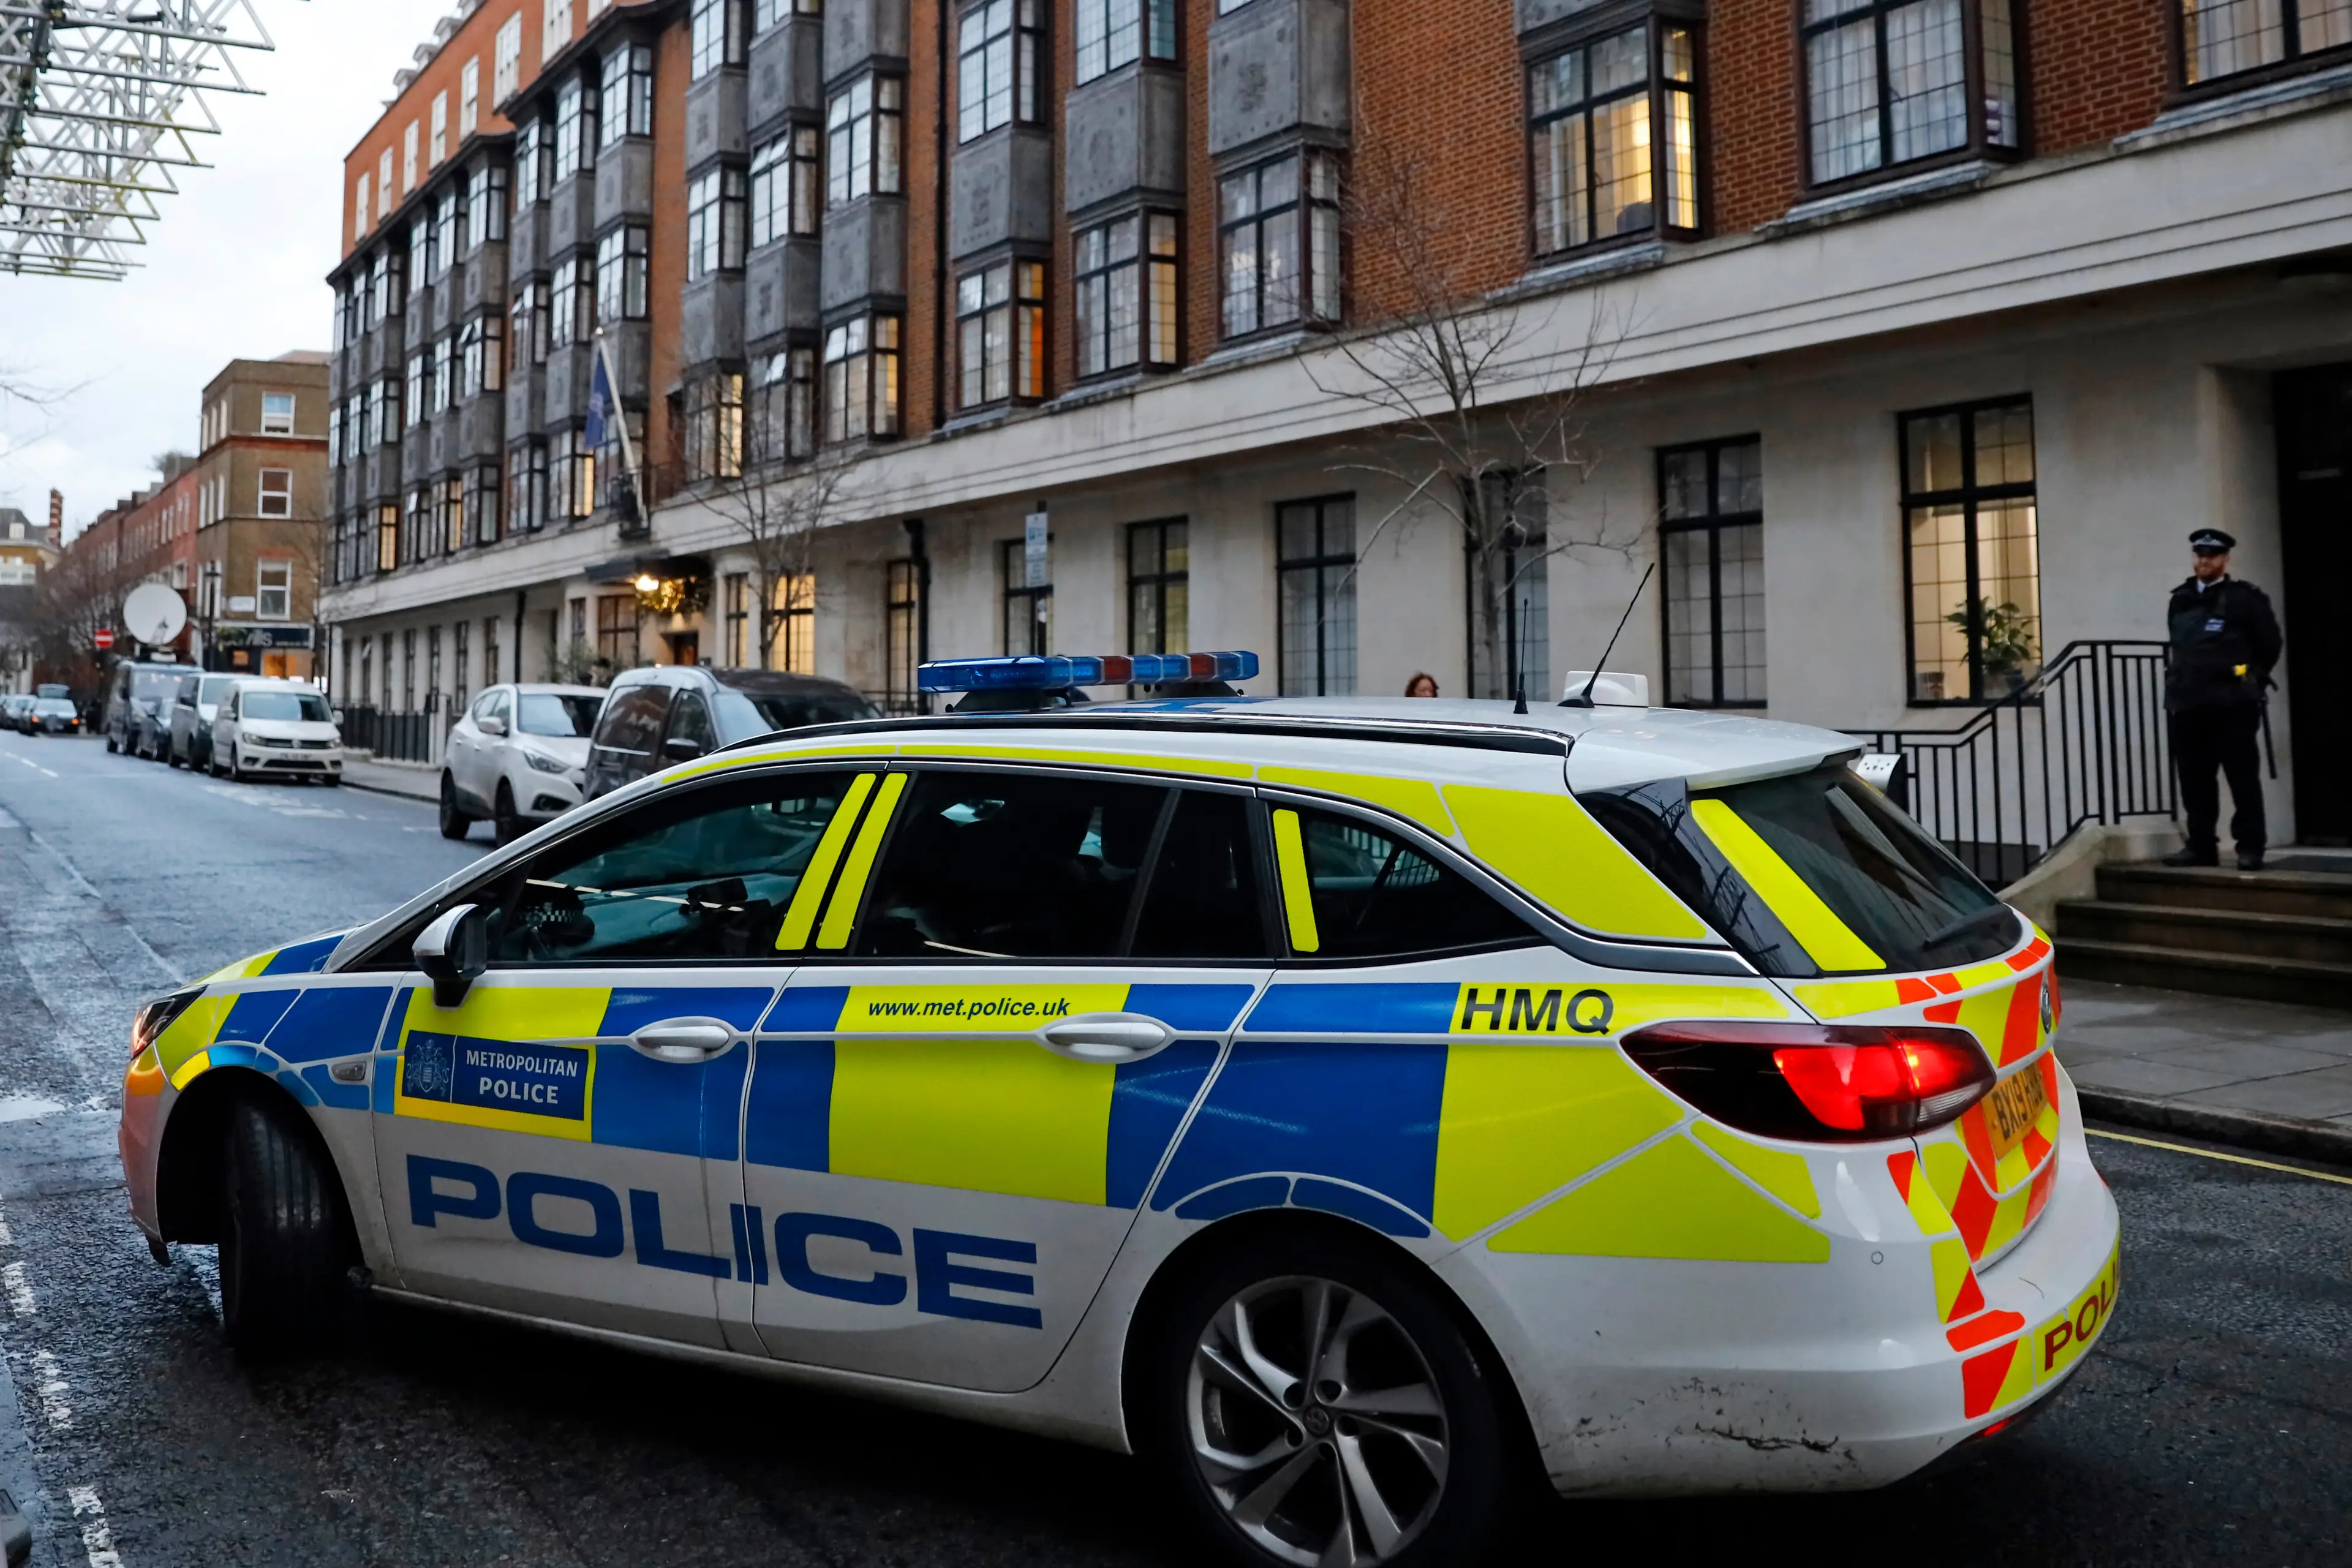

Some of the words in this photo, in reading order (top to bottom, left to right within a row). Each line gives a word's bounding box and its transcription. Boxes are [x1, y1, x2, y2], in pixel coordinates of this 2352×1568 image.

[869, 998, 1070, 1020] www.met.police.uk
[1461, 988, 1614, 1035] HMQ
[466, 1050, 578, 1077] METROPOLITAN
[479, 1077, 559, 1104] POLICE
[406, 1154, 1043, 1330] POLICE
